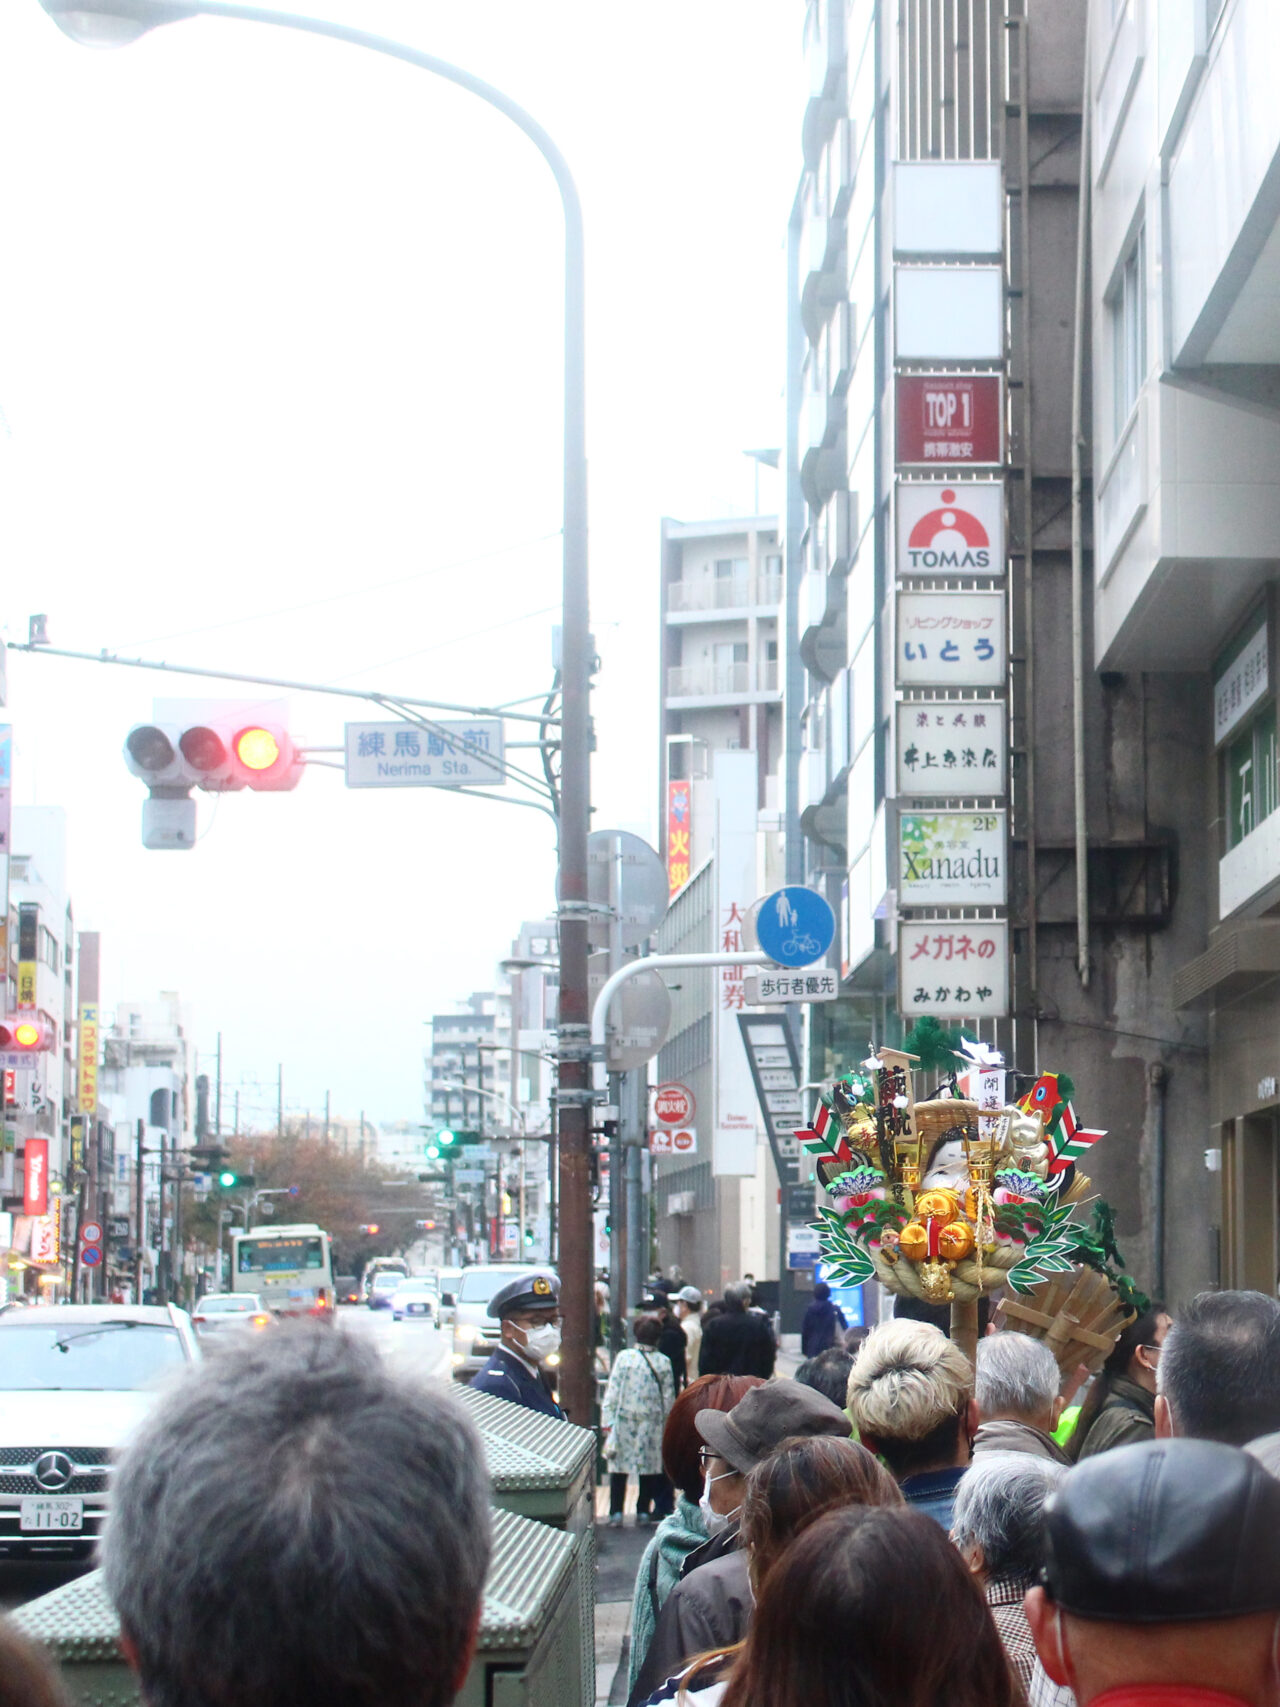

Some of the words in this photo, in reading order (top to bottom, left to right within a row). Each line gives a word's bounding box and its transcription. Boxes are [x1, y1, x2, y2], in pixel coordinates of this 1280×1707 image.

[925, 392, 957, 428] TOP
[962, 392, 970, 428] 1
[908, 550, 990, 567] TOMAS
[906, 616, 994, 630] リビングショップ
[904, 638, 994, 661] いとう
[357, 728, 491, 758] 練馬駅前
[377, 761, 432, 777] Nerima
[442, 760, 472, 776] Sta.
[973, 816, 997, 831] 2F
[902, 848, 1000, 880] Xanadu
[910, 935, 996, 960] メガネの
[761, 976, 835, 996] 歩行者優先
[913, 986, 993, 1003] みかわや
